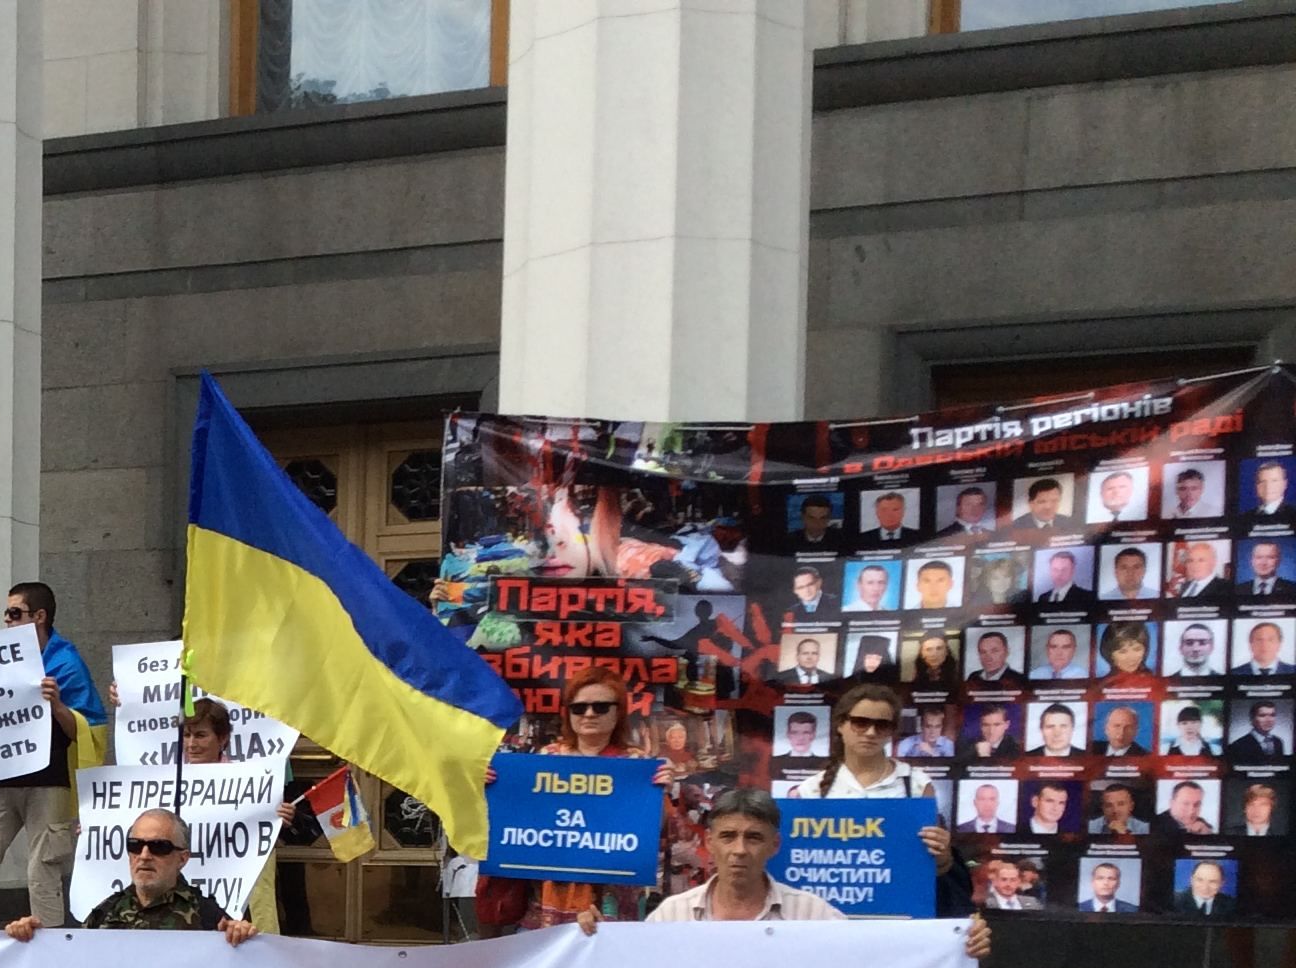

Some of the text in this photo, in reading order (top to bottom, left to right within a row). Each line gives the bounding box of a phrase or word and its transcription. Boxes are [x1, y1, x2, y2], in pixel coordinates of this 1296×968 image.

[909, 394, 1173, 449] Партія регіонів
[496, 578, 666, 619] Партія,
[533, 621, 623, 647] яка
[137, 657, 169, 673] без
[128, 715, 180, 733] снова
[92, 768, 274, 810] НЕ ПРЕВРАЩАЙ
[532, 772, 614, 796] ЛЬВІВ
[555, 809, 586, 827] ЗА
[790, 818, 885, 841] ЛУЦЬК
[257, 821, 273, 857] В
[500, 827, 639, 853] ЛЮСТРАЦІЮ
[790, 849, 885, 865] ВИМАГАЄ
[785, 867, 892, 884] ОЧИСТИТИ
